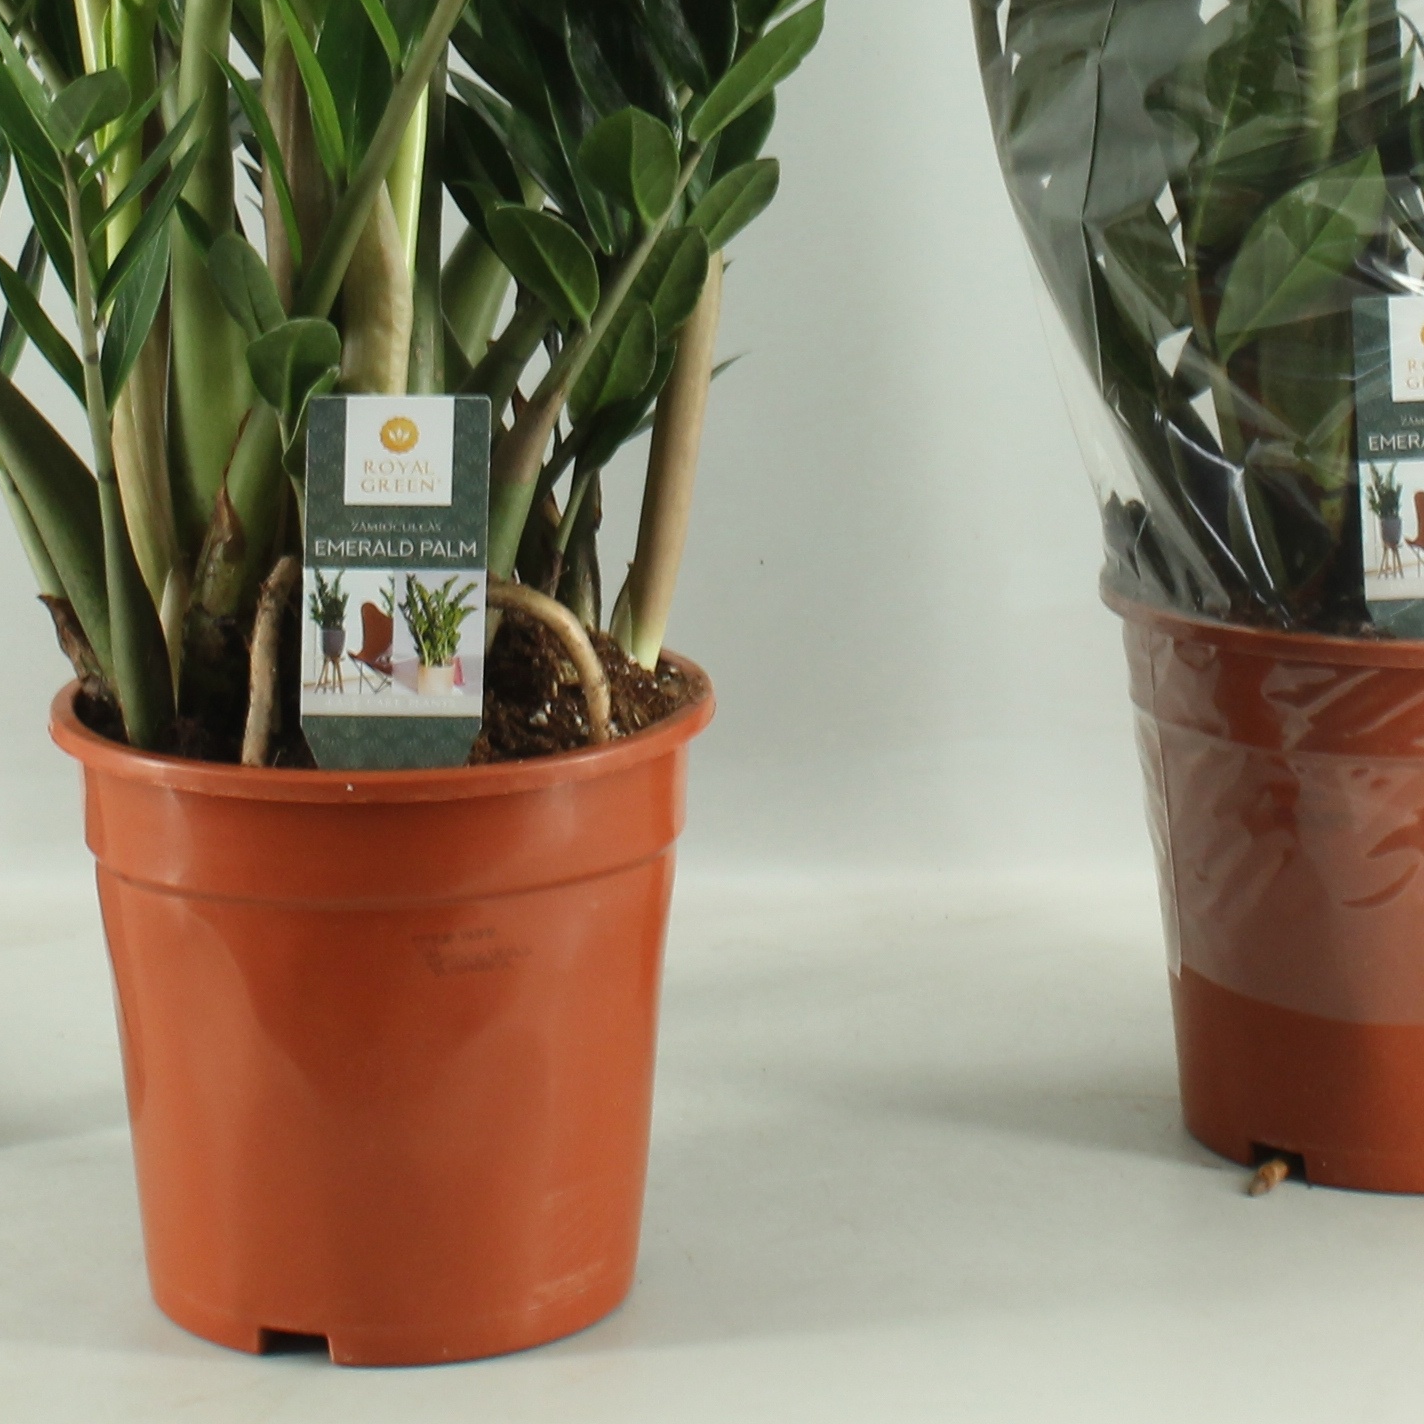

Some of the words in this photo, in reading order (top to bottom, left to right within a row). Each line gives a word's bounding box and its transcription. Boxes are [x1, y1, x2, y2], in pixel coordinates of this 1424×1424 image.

[364, 459, 435, 475] ROYAL
[360, 478, 435, 493] GREEN
[314, 539, 415, 558] EMERALD
[420, 539, 477, 558] PALM
